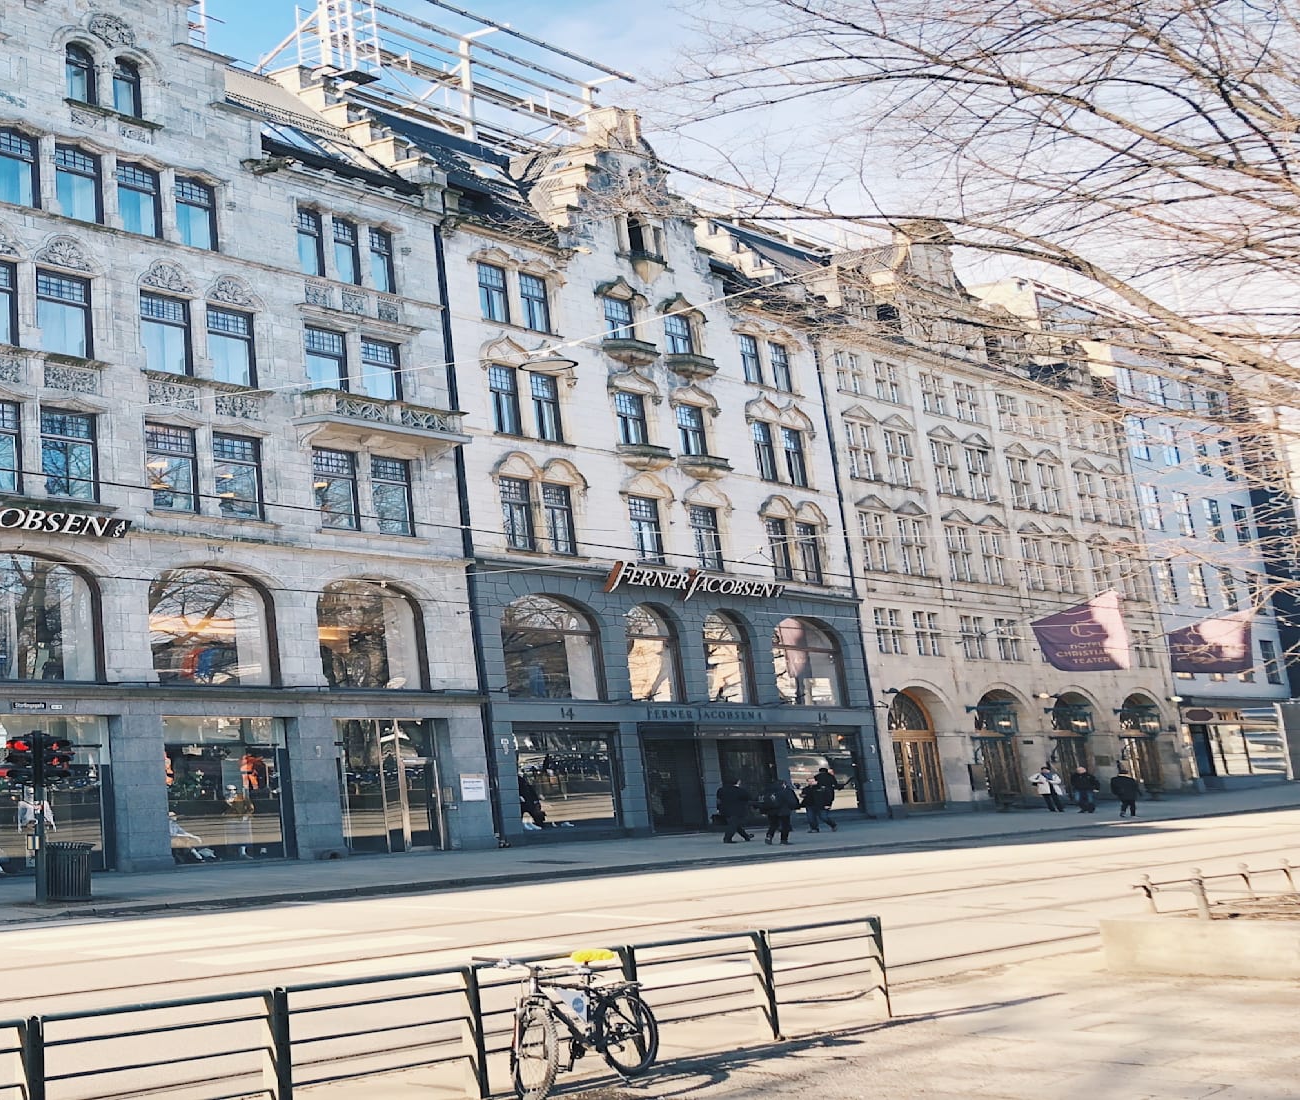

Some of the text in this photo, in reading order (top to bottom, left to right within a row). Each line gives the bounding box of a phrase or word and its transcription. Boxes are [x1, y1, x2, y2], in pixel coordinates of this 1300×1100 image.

[608, 560, 690, 593] FERNER
[683, 570, 774, 602] JACOBSEN
[560, 707, 575, 721] 14
